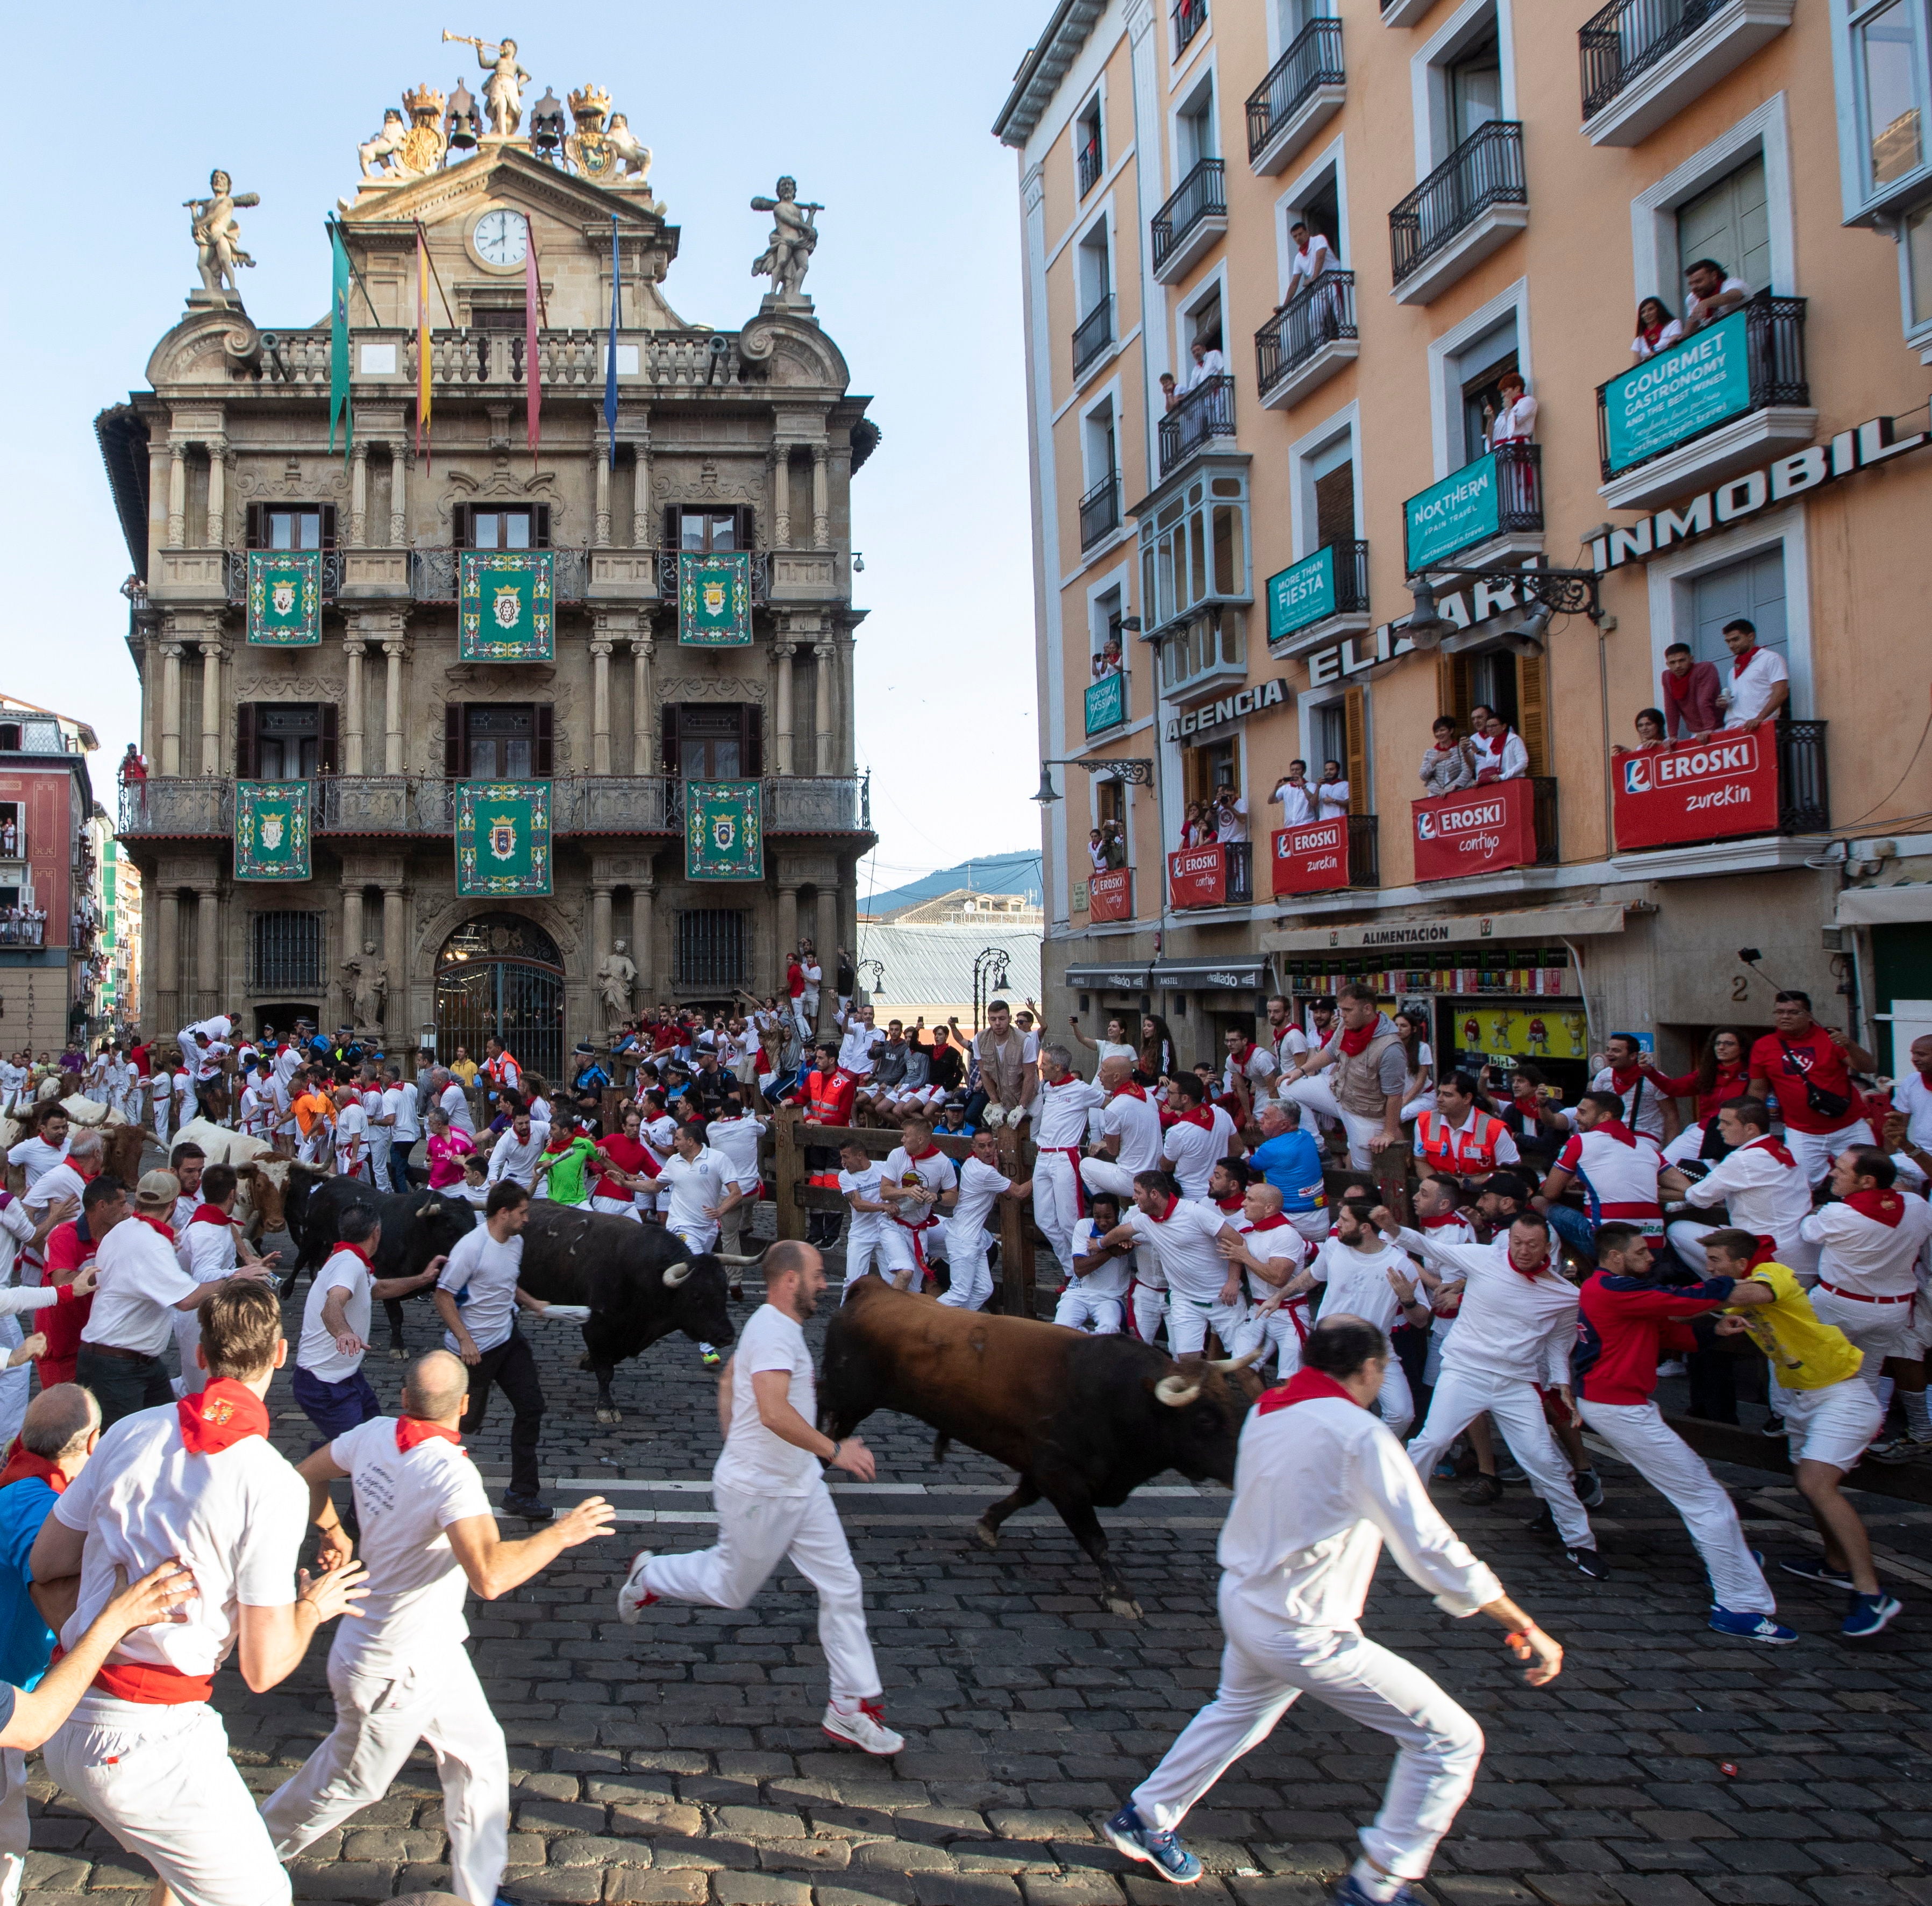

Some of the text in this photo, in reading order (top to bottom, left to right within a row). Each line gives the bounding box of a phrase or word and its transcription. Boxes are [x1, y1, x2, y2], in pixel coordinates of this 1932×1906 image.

[1624, 331, 1725, 399] GOURMET
[1625, 353, 1727, 416] GASTRONOMY
[1626, 370, 1727, 428] AND THE BEST WINES
[1415, 473, 1488, 525] NORTHERN
[1424, 504, 1478, 537] SPAIN TRAVEL
[1165, 680, 1284, 742] AGENCIA
[1592, 417, 1932, 574] INMOBIL
[1278, 560, 1323, 592] MORE THAN
[1279, 574, 1324, 610] FIESTA
[1090, 693, 1117, 715] PASSION
[1661, 744, 1749, 780] EROSKI
[1442, 804, 1500, 831] EROSKI
[1295, 829, 1336, 851] EROSKI
[1459, 831, 1499, 858] contigo
[1186, 854, 1217, 871] EROSKI
[1100, 877, 1122, 891] EROSKI
[1196, 873, 1216, 892] contigo
[1107, 893, 1122, 909] contigo
[1363, 924, 1449, 944] ALIMENTACIÓN
[1160, 977, 1178, 985] AMSTEL
[1731, 976, 1748, 1001] 2
